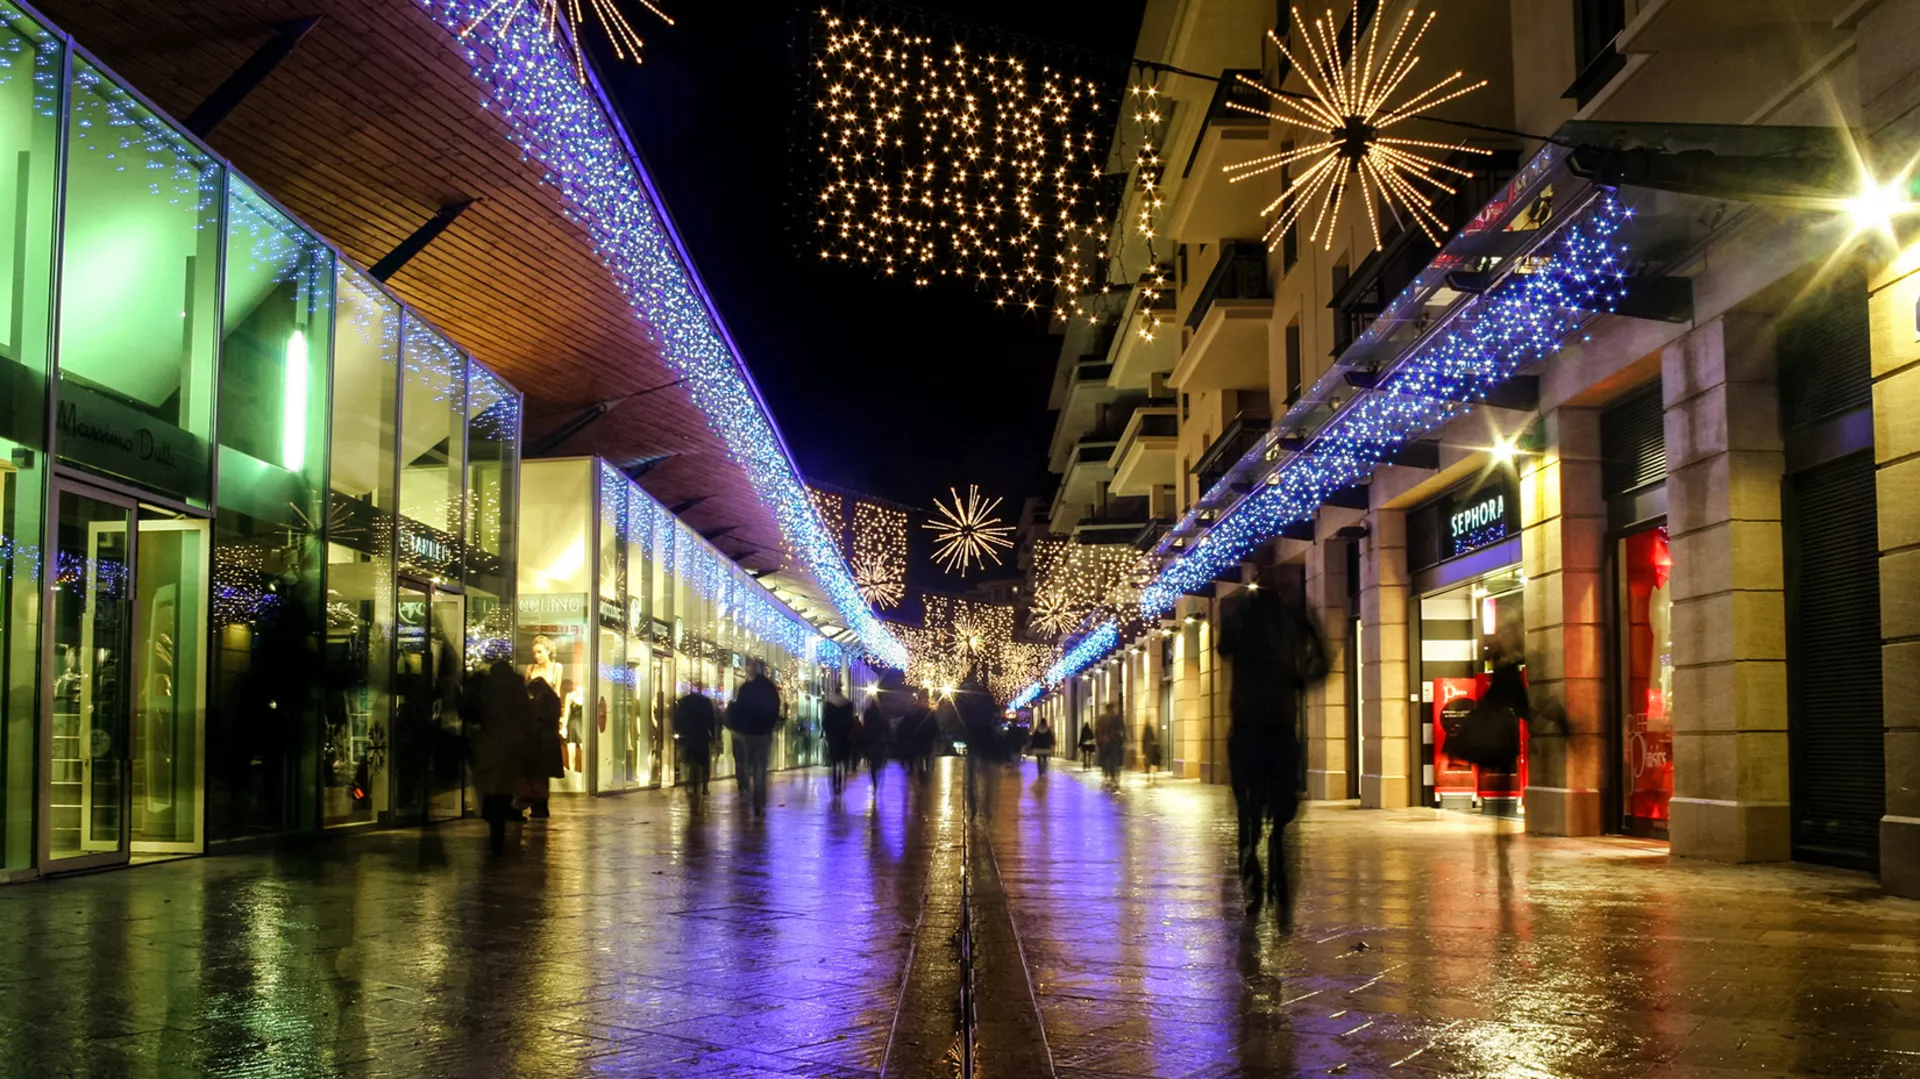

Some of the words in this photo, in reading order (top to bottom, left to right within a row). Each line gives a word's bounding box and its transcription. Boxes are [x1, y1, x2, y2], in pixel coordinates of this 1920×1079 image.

[57, 400, 134, 452] Massimo
[137, 428, 177, 468] Dutti
[1451, 494, 1505, 538] SEPHORA
